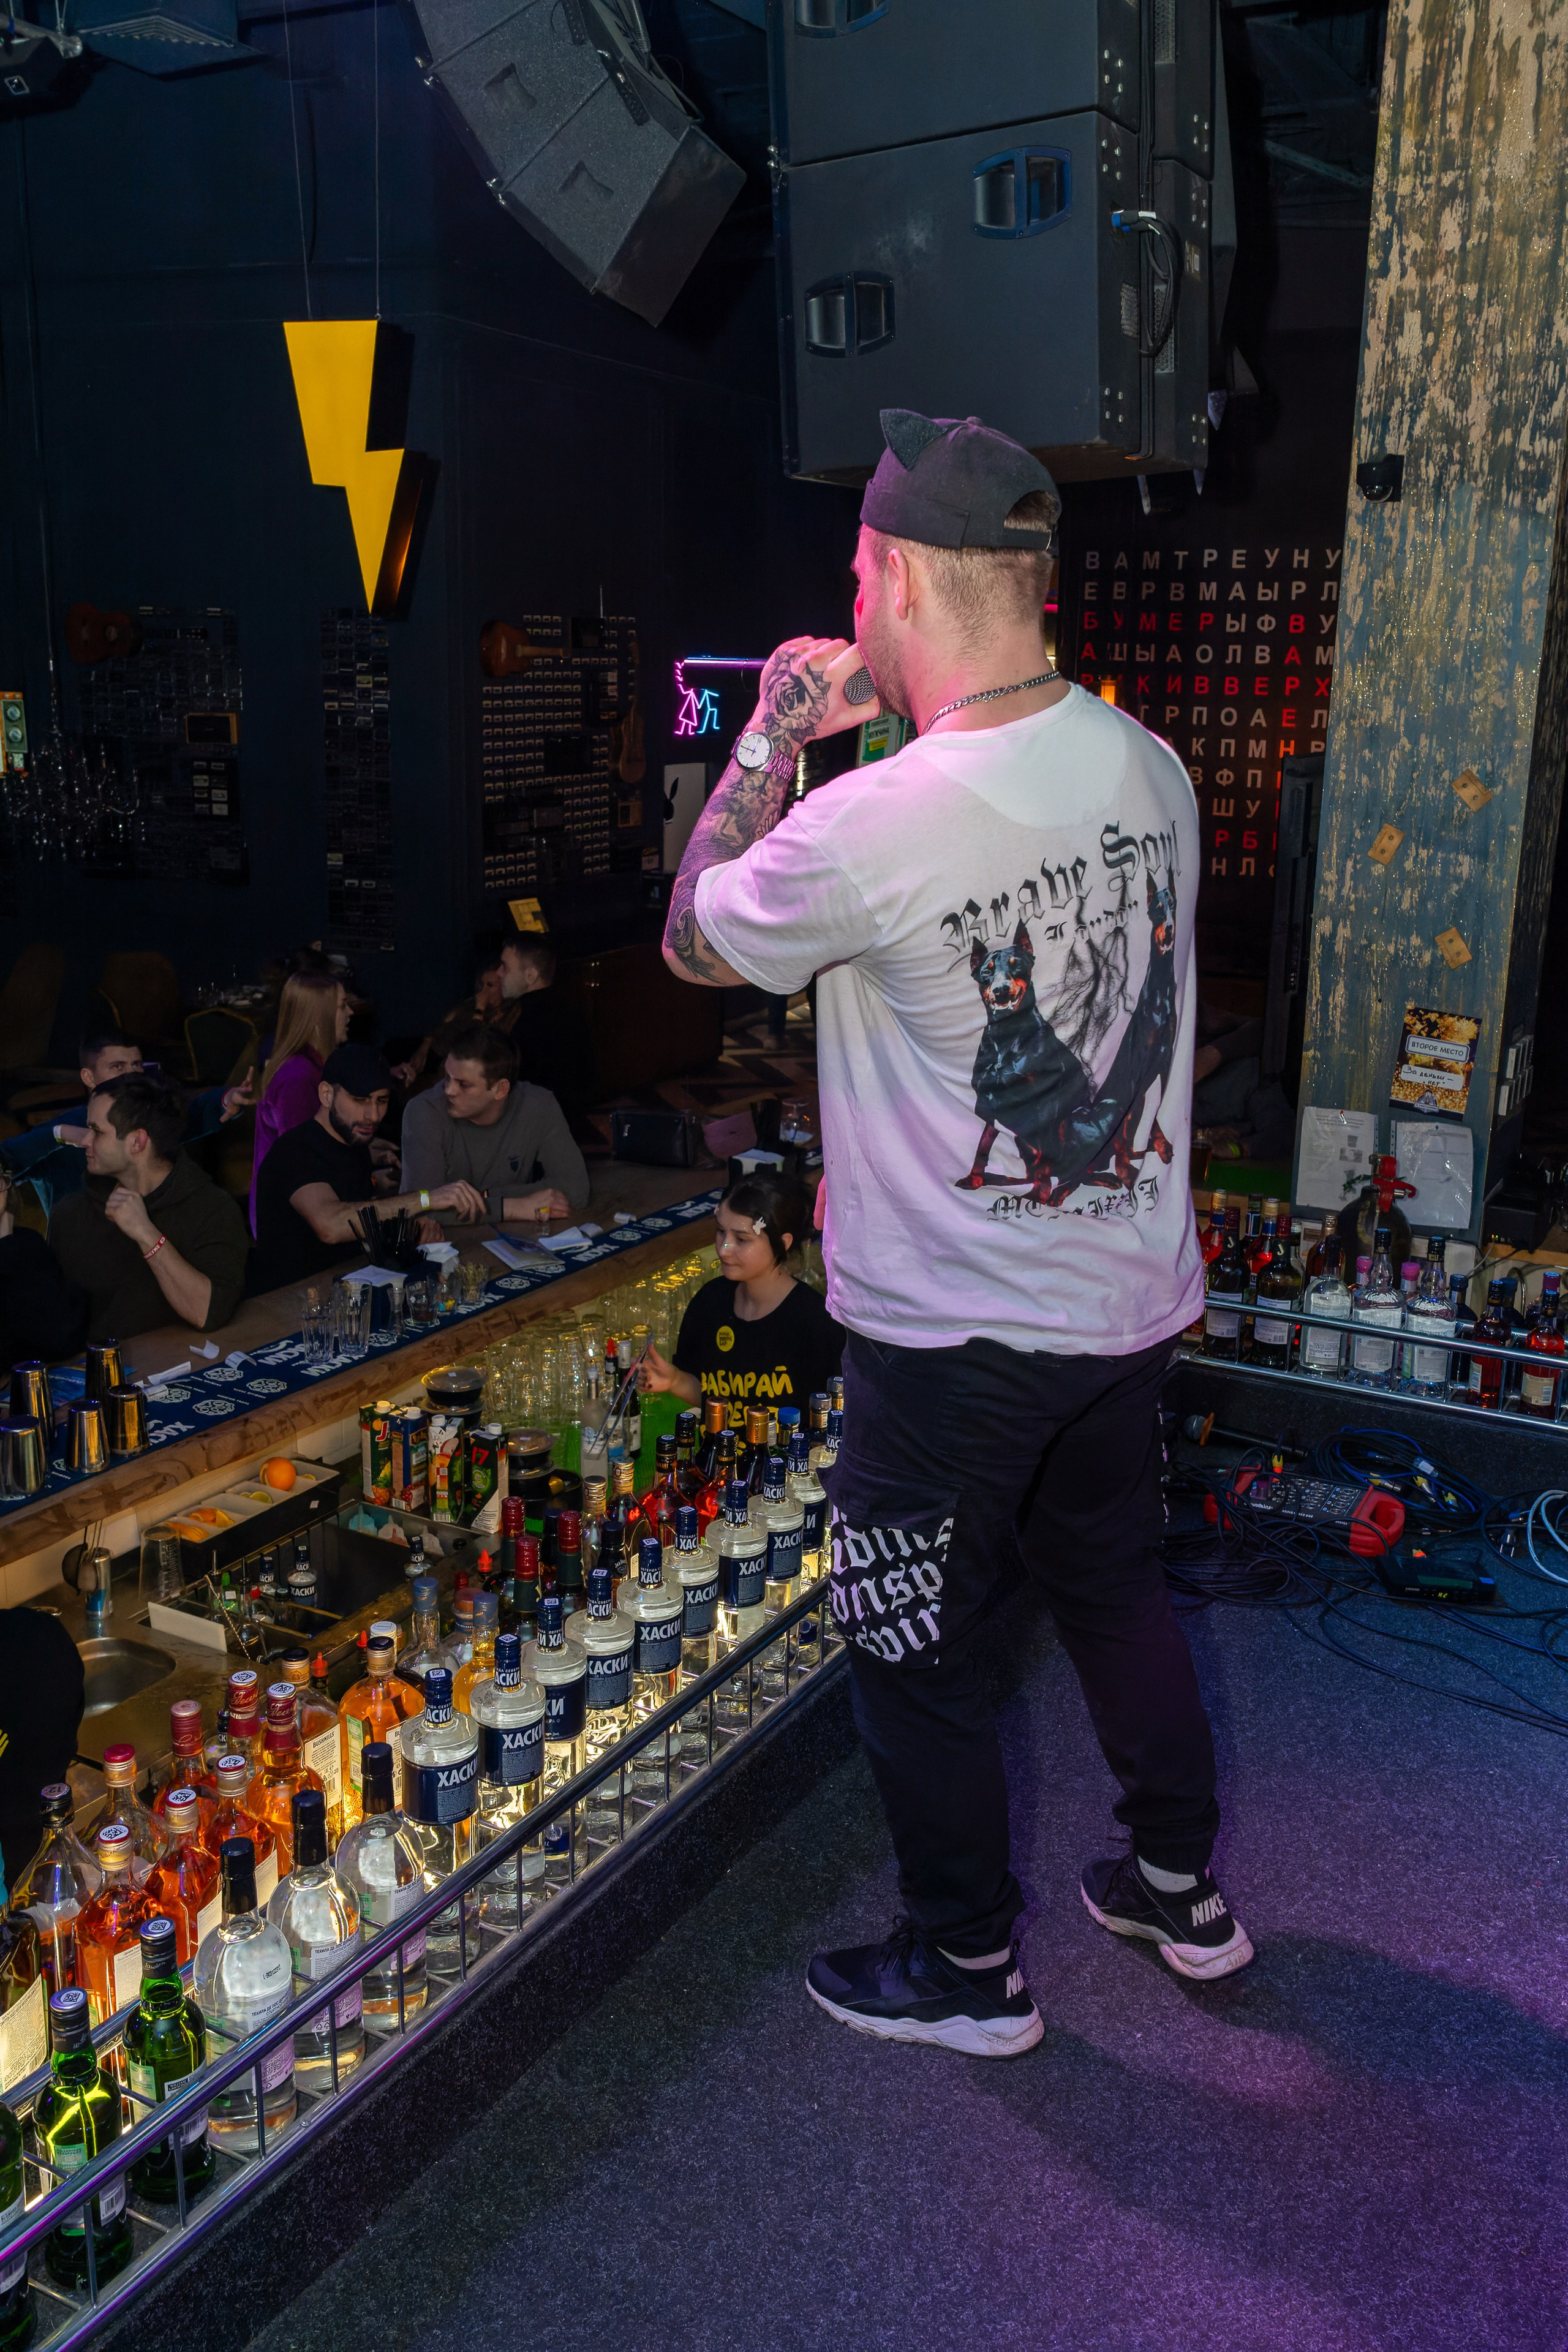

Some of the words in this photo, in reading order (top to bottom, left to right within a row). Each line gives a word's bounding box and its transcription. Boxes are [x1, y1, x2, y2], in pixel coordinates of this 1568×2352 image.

[940, 856, 1093, 972] Brave
[1412, 1041, 1438, 1051] ВТОРОЕ
[1440, 1047, 1464, 1057] МЕСТО
[640, 1618, 680, 1641] ХАСКИ
[313, 1731, 334, 1748] BUSHMILLS
[1191, 1892, 1226, 1926] NIKE
[252, 2008, 266, 2017] ТЕКИЛА
